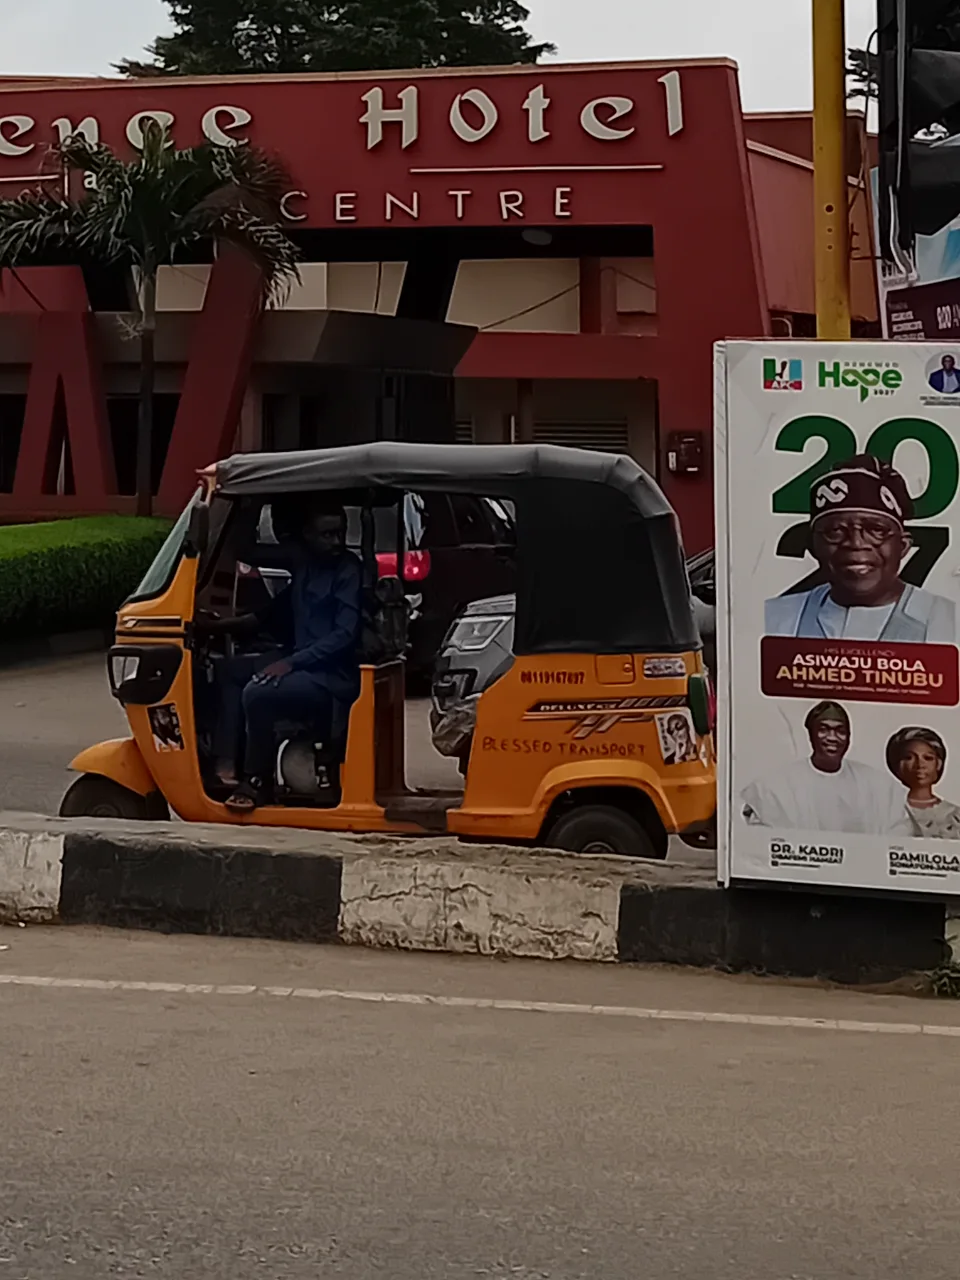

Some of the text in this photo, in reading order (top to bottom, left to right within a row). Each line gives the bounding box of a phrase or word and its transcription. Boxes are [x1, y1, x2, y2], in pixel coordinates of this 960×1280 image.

[280, 187, 572, 221] CENTRE
[818, 361, 902, 402] Hope
[772, 414, 959, 520] 20
[792, 653, 926, 672] ASIWAJU BOLA
[776, 665, 944, 688] AHMED TINUBU
[482, 735, 647, 757] BLESSED TRANSPORT
[771, 843, 844, 858] DR. KADRI
[889, 851, 960, 865] DAMILOLA
